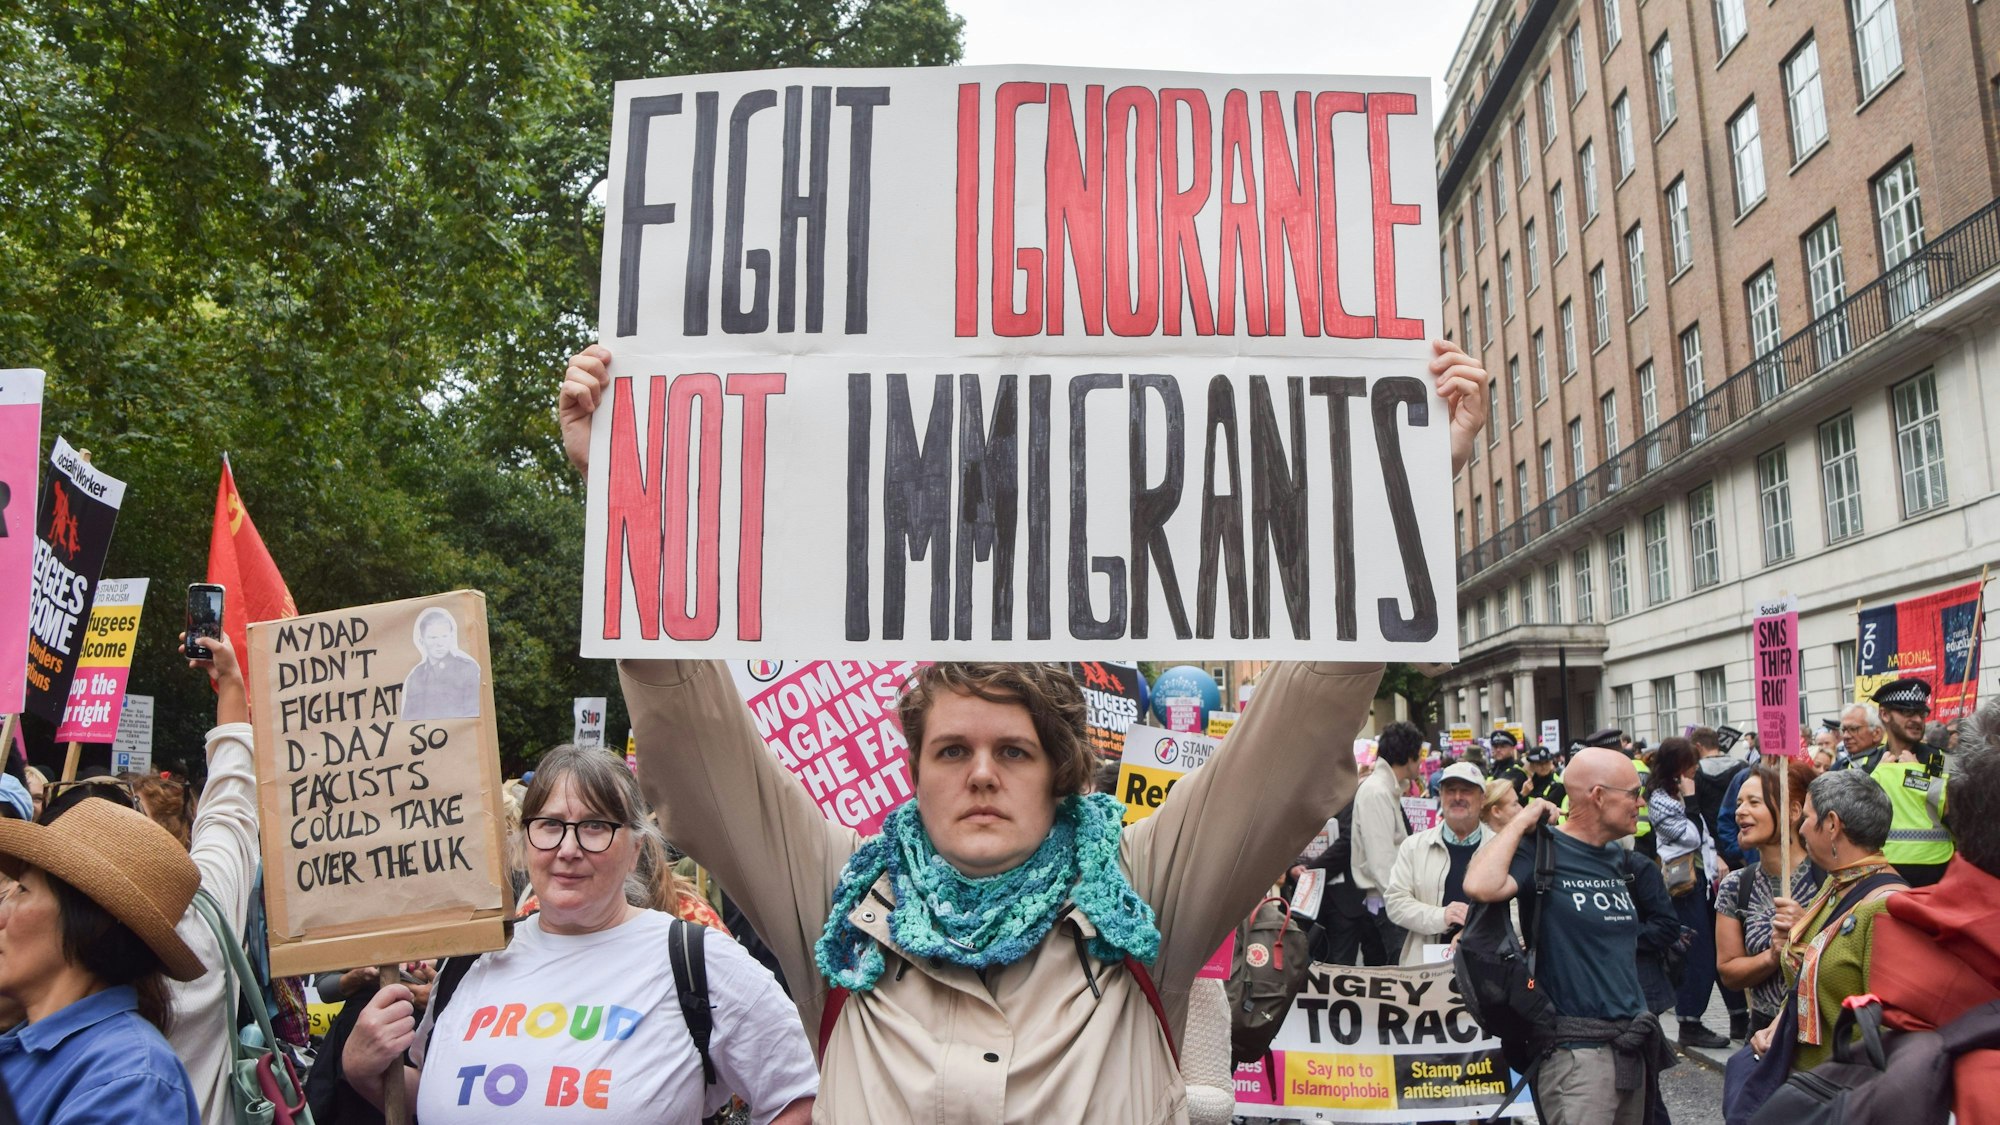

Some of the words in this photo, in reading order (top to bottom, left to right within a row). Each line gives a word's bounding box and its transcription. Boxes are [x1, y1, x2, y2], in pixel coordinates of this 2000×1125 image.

[616, 86, 890, 337] FIGHT
[955, 81, 1424, 339] IGNORANCE
[602, 373, 786, 641] NOT
[845, 374, 1438, 642] IMMIGRANTS
[100, 583, 118, 593] STAND
[120, 583, 128, 592] UP
[105, 593, 130, 602] RACISM
[275, 622, 315, 654] MY
[318, 617, 369, 650] DAD
[278, 649, 377, 691] DIDN'T
[1887, 649, 1933, 668] NATIONAL
[90, 673, 117, 695] the
[750, 660, 888, 739] WOMEN
[72, 700, 111, 727] right
[280, 688, 367, 734] FIGHT
[371, 682, 403, 719] AT
[581, 709, 600, 726] Stop
[286, 721, 395, 772] D-DAY
[408, 724, 448, 756] SO
[1181, 754, 1194, 769] TO
[821, 757, 912, 827] IGHT
[290, 809, 380, 850] COULD
[391, 793, 464, 831] TAKE
[297, 851, 365, 892] OVER
[366, 840, 418, 880] THE
[421, 835, 473, 874] UK
[1562, 879, 1616, 888] HIGHGATE
[462, 1003, 645, 1042] PROUD
[1296, 998, 1362, 1045] TO
[1378, 1003, 1492, 1045] RAC
[456, 1063, 529, 1107] TO
[544, 1065, 612, 1110] BE
[1306, 1059, 1332, 1079] Say
[1338, 1064, 1355, 1077] no
[1359, 1063, 1374, 1078] to
[1411, 1060, 1462, 1082] Stamp
[1466, 1057, 1493, 1076] out
[1292, 1079, 1390, 1101] Islamophobia
[1403, 1078, 1506, 1099] antisemitism
